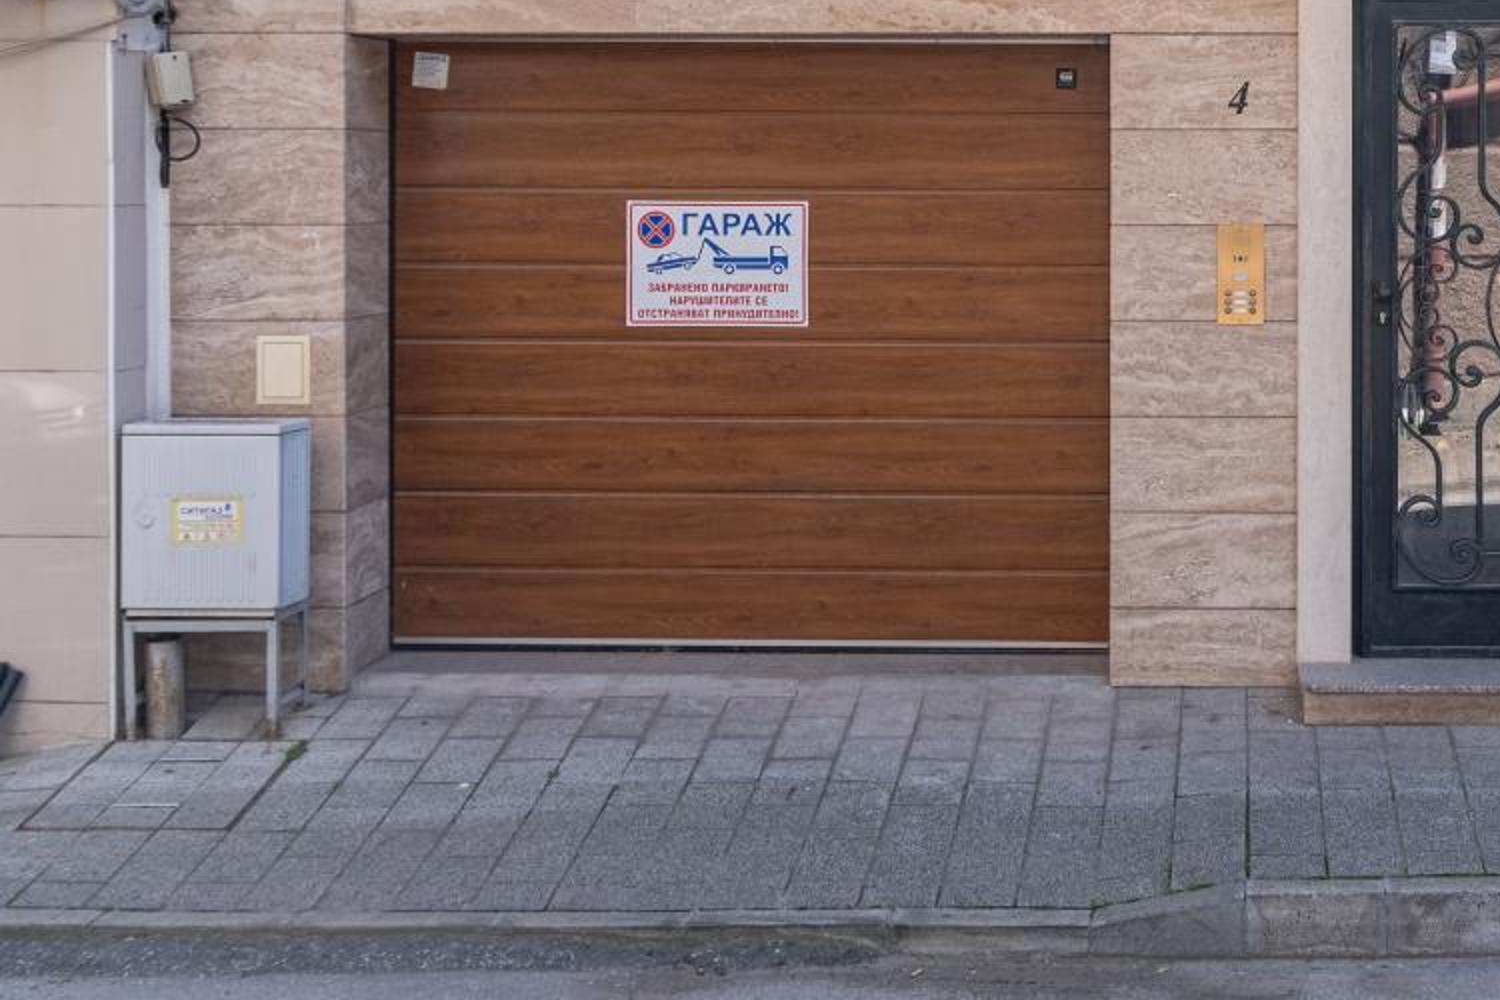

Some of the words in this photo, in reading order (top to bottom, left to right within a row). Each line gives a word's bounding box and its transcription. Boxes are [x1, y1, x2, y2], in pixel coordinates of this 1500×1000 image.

[1228, 81, 1249, 114] 4
[682, 213, 792, 236] ГАРАЖ
[648, 283, 708, 293] ЗАБРАНЕНО
[669, 296, 750, 306] НАРУШИТЕЛИТЕ
[755, 296, 768, 306] СЕ
[637, 309, 709, 319] ОТСТРАНЯВАТ
